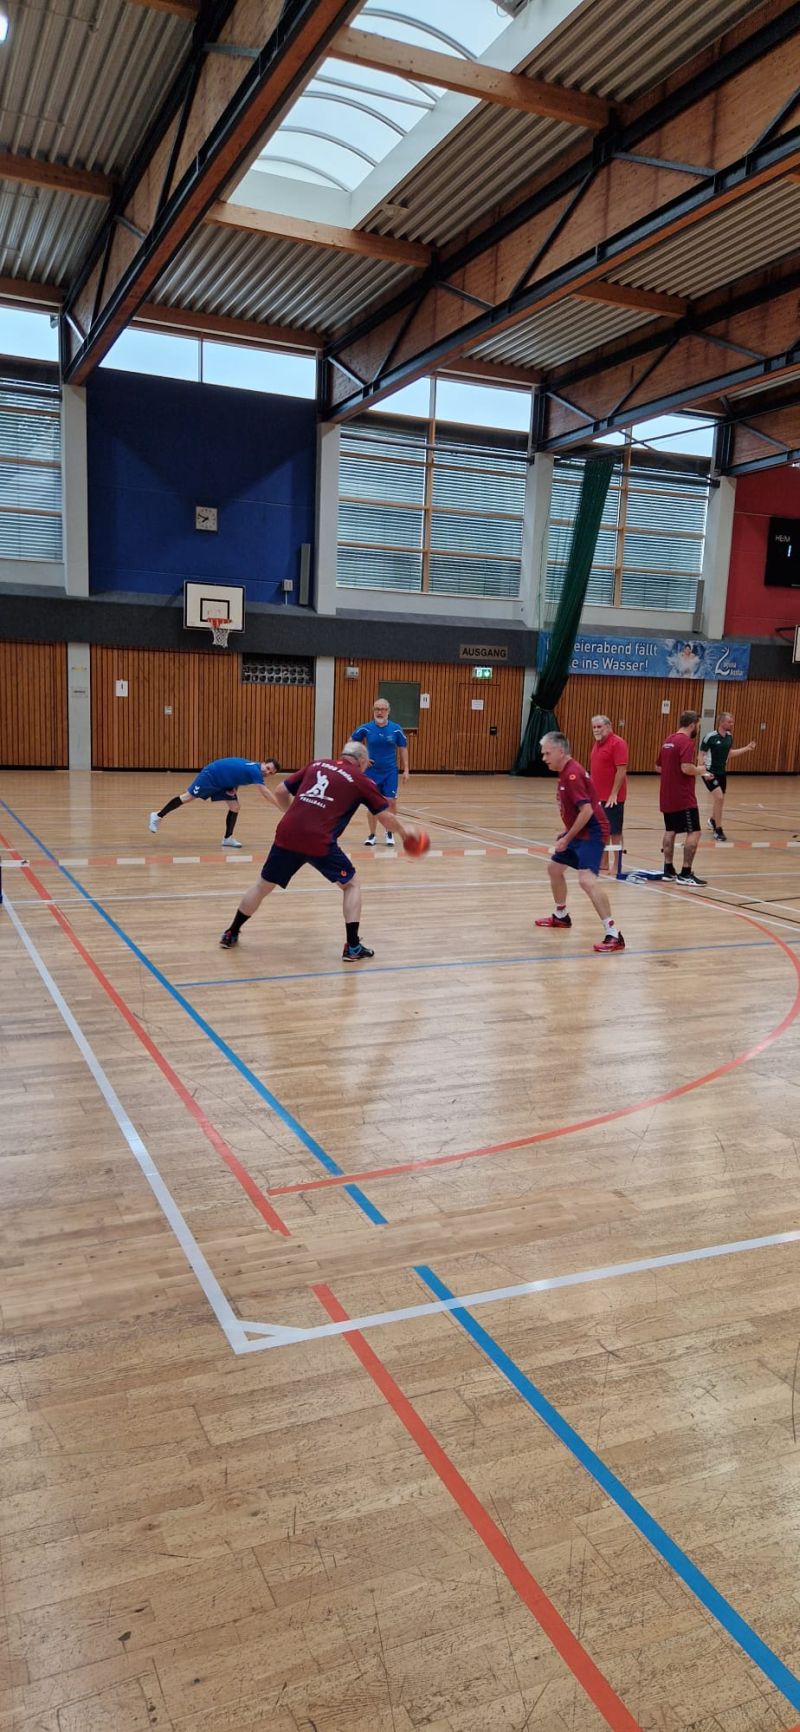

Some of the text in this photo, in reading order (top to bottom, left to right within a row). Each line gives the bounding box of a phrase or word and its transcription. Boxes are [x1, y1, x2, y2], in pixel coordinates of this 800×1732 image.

[462, 647, 507, 657] AUSGANG
[573, 640, 658, 656] eierabend fällt
[582, 657, 600, 669] ins
[602, 657, 649, 671] Wasser!
